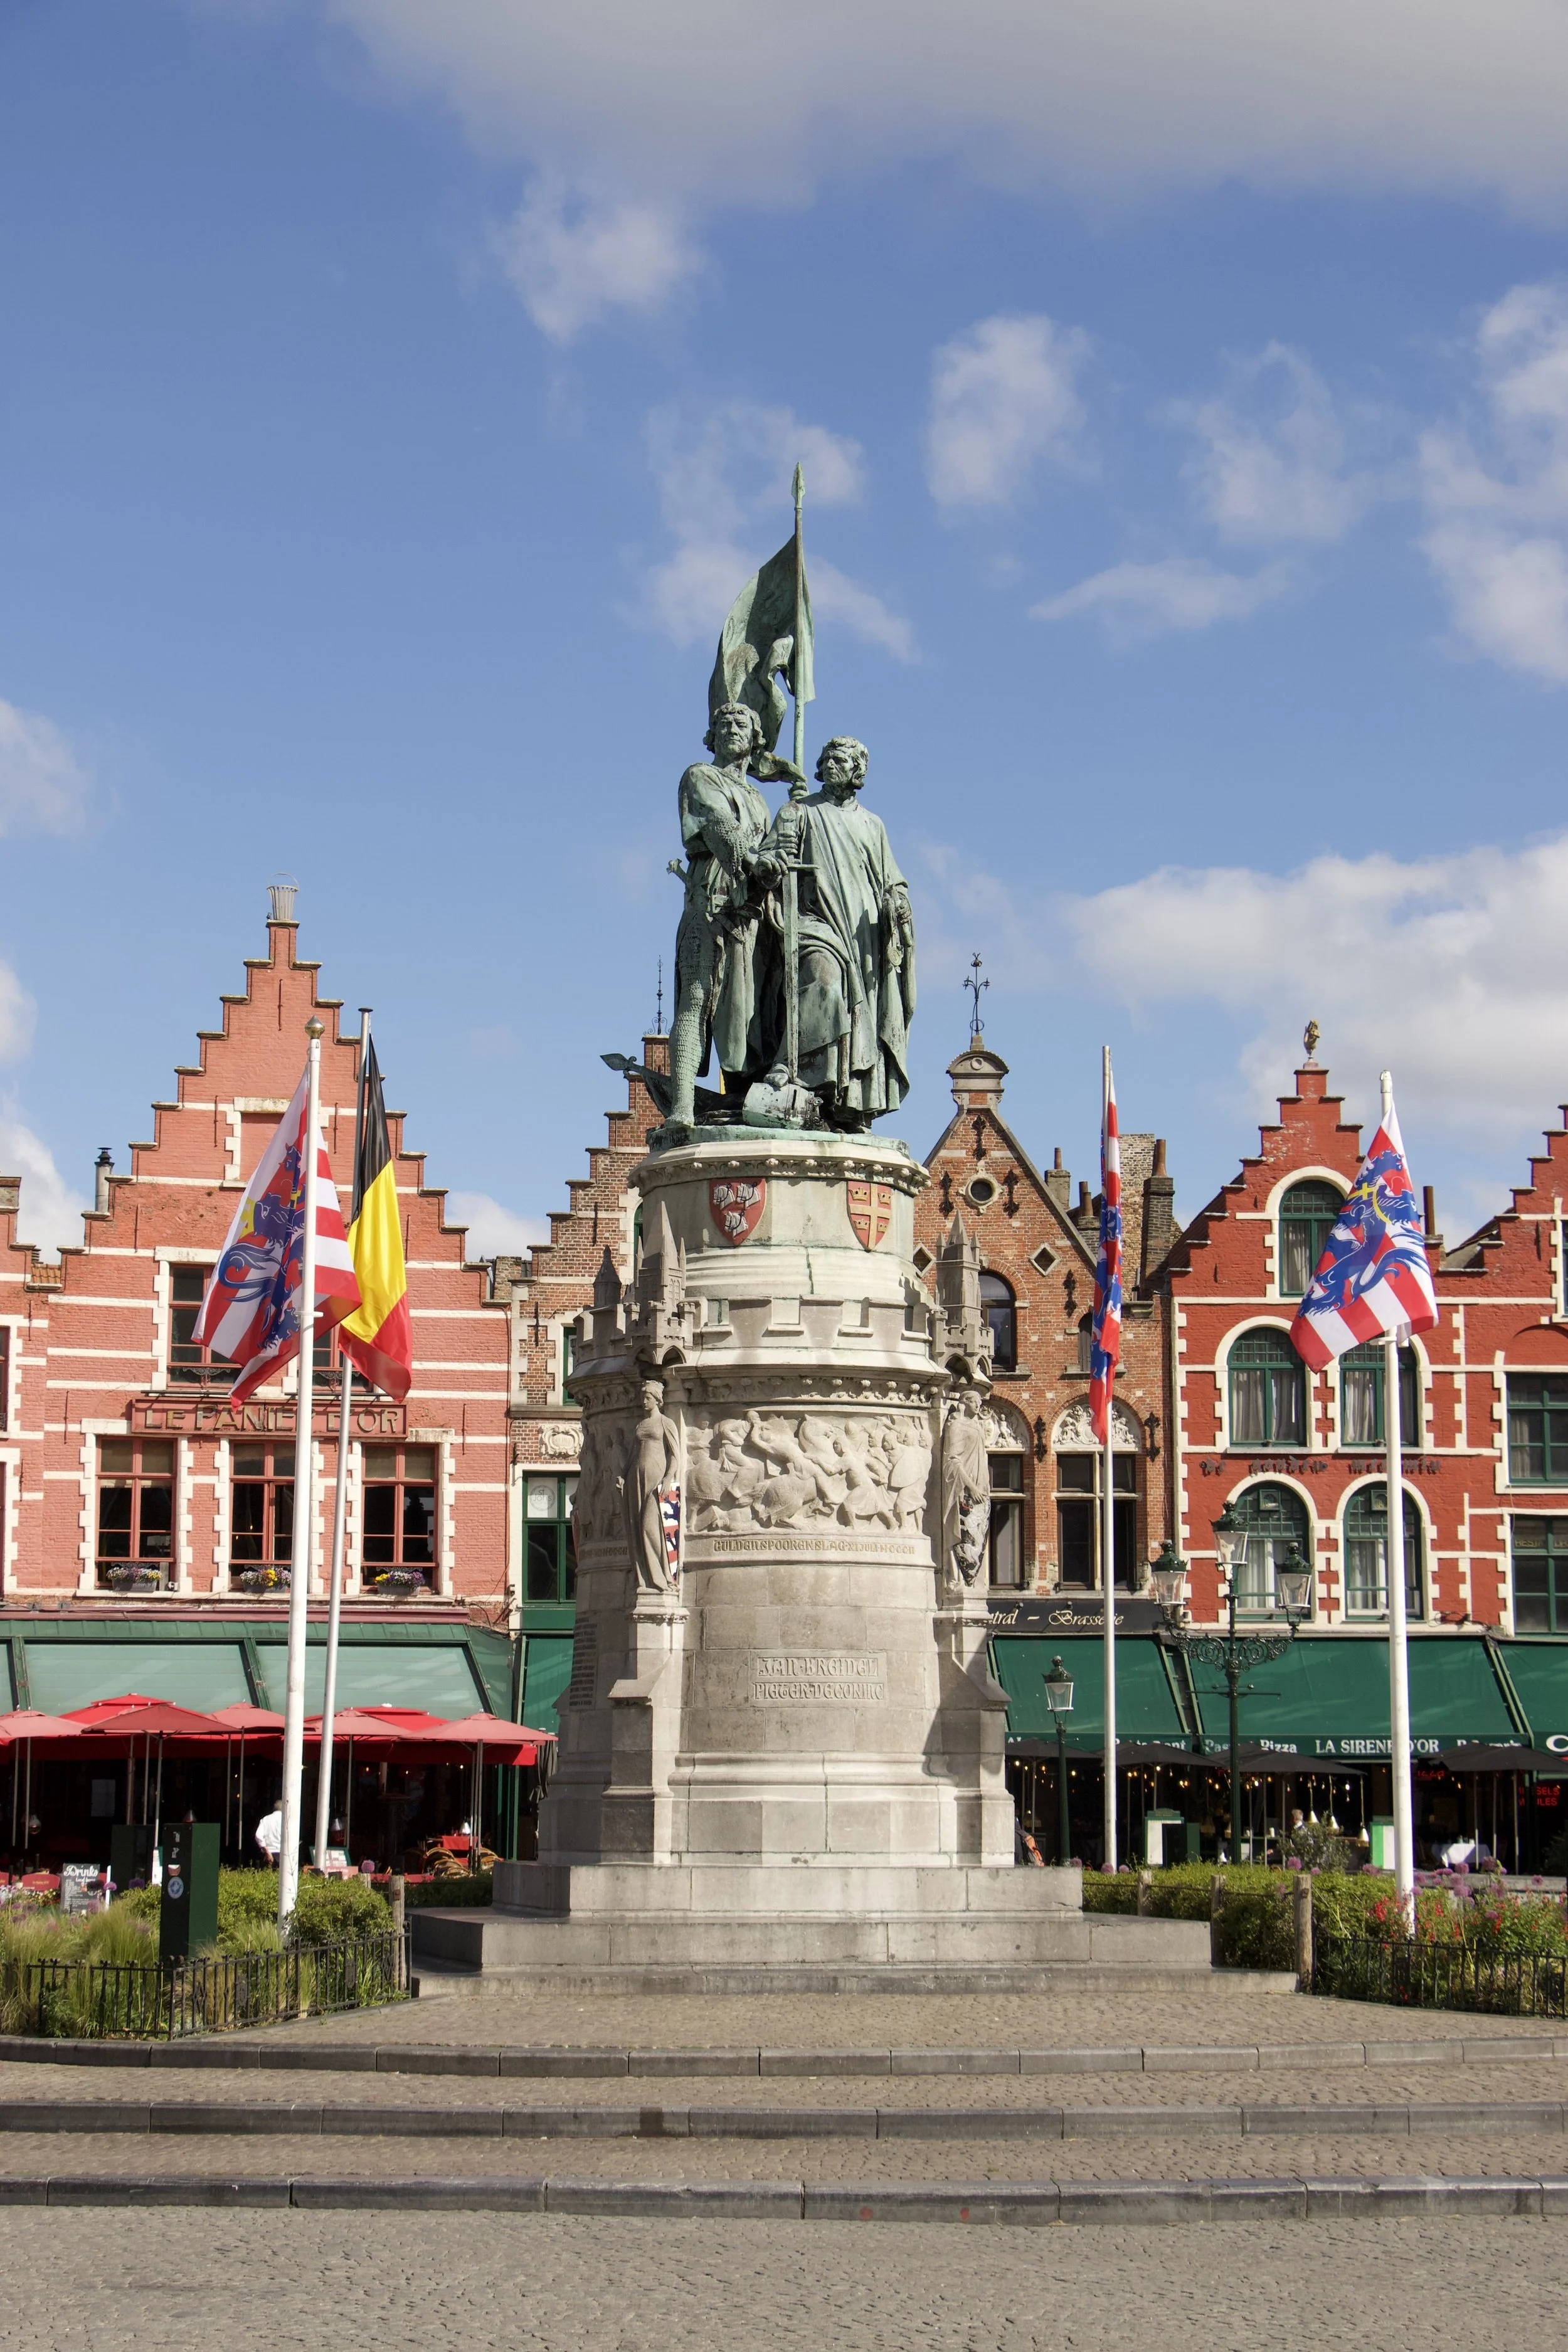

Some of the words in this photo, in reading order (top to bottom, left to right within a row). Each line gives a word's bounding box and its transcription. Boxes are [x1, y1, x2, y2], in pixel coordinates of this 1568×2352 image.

[145, 1409, 186, 1429] LE
[196, 1404, 316, 1433] PANIE
[990, 1608, 1019, 1625] tral
[1048, 1609, 1125, 1626] Brasseie
[1315, 1739, 1336, 1754] LA
[63, 1865, 98, 1877] Drinks
